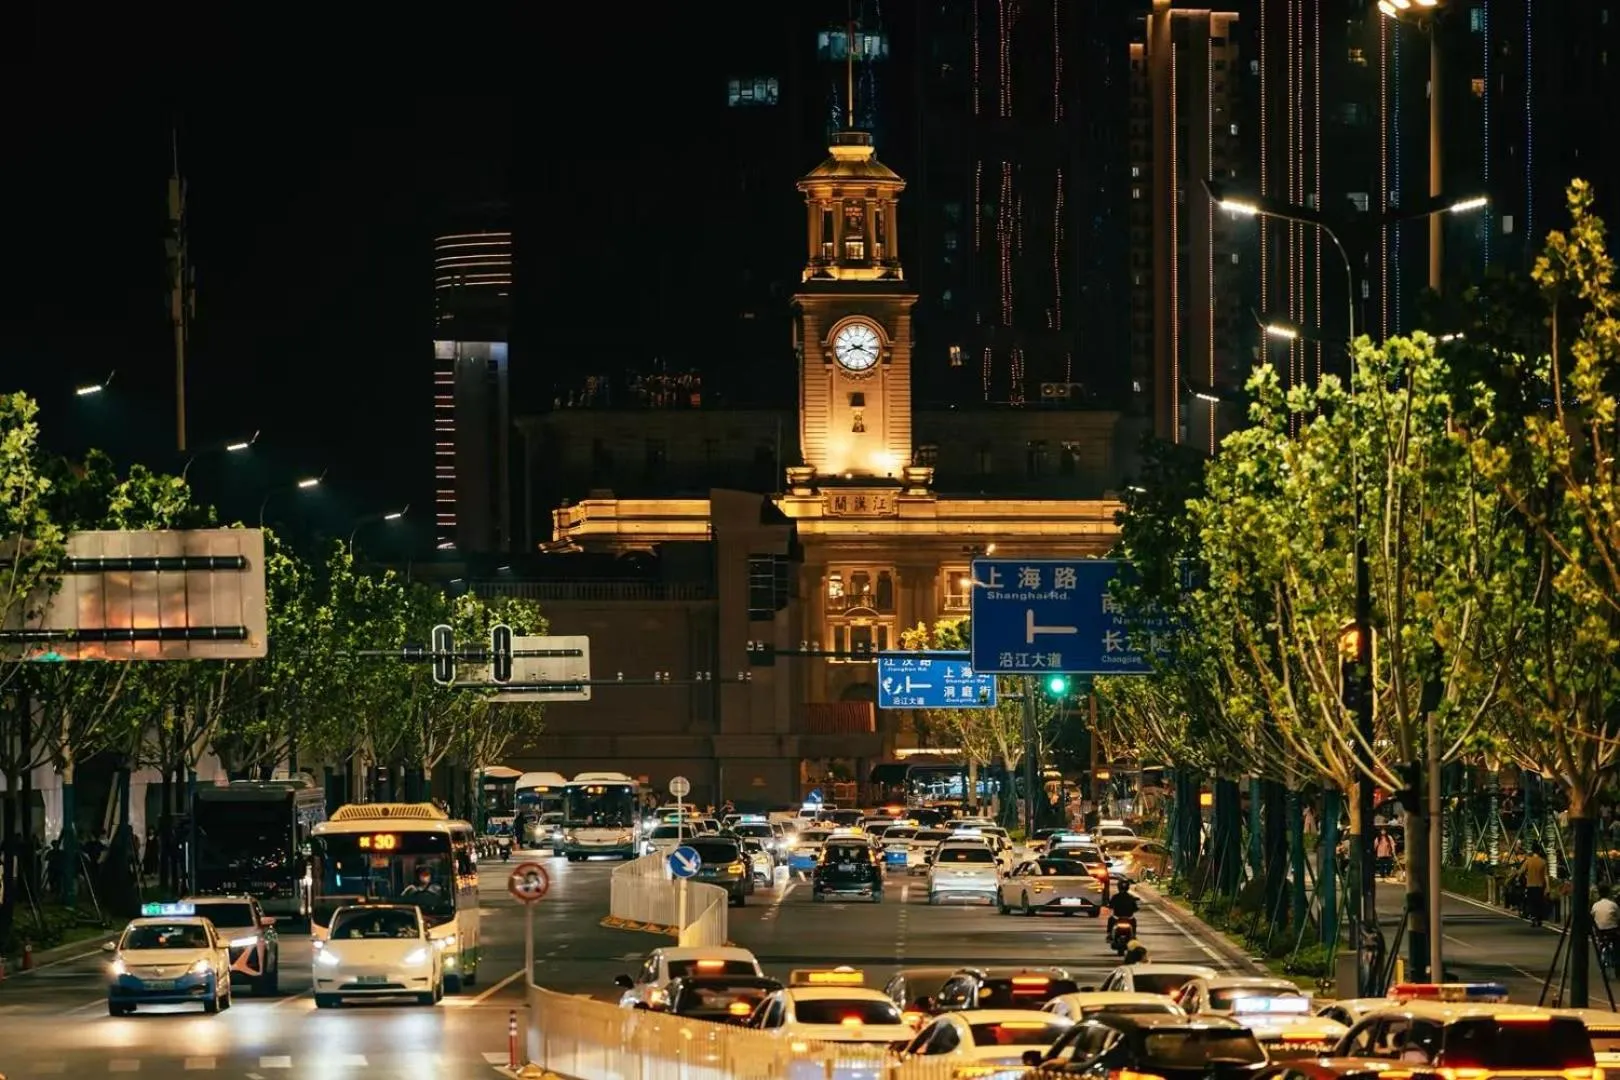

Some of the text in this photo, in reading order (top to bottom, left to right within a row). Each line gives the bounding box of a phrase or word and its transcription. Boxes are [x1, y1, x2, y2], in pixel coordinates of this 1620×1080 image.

[984, 566, 1078, 590] 上海路
[987, 591, 1048, 600] Shanghai
[999, 652, 1063, 668] 沿江大道
[943, 666, 990, 678] 上海
[374, 834, 396, 849] 30
